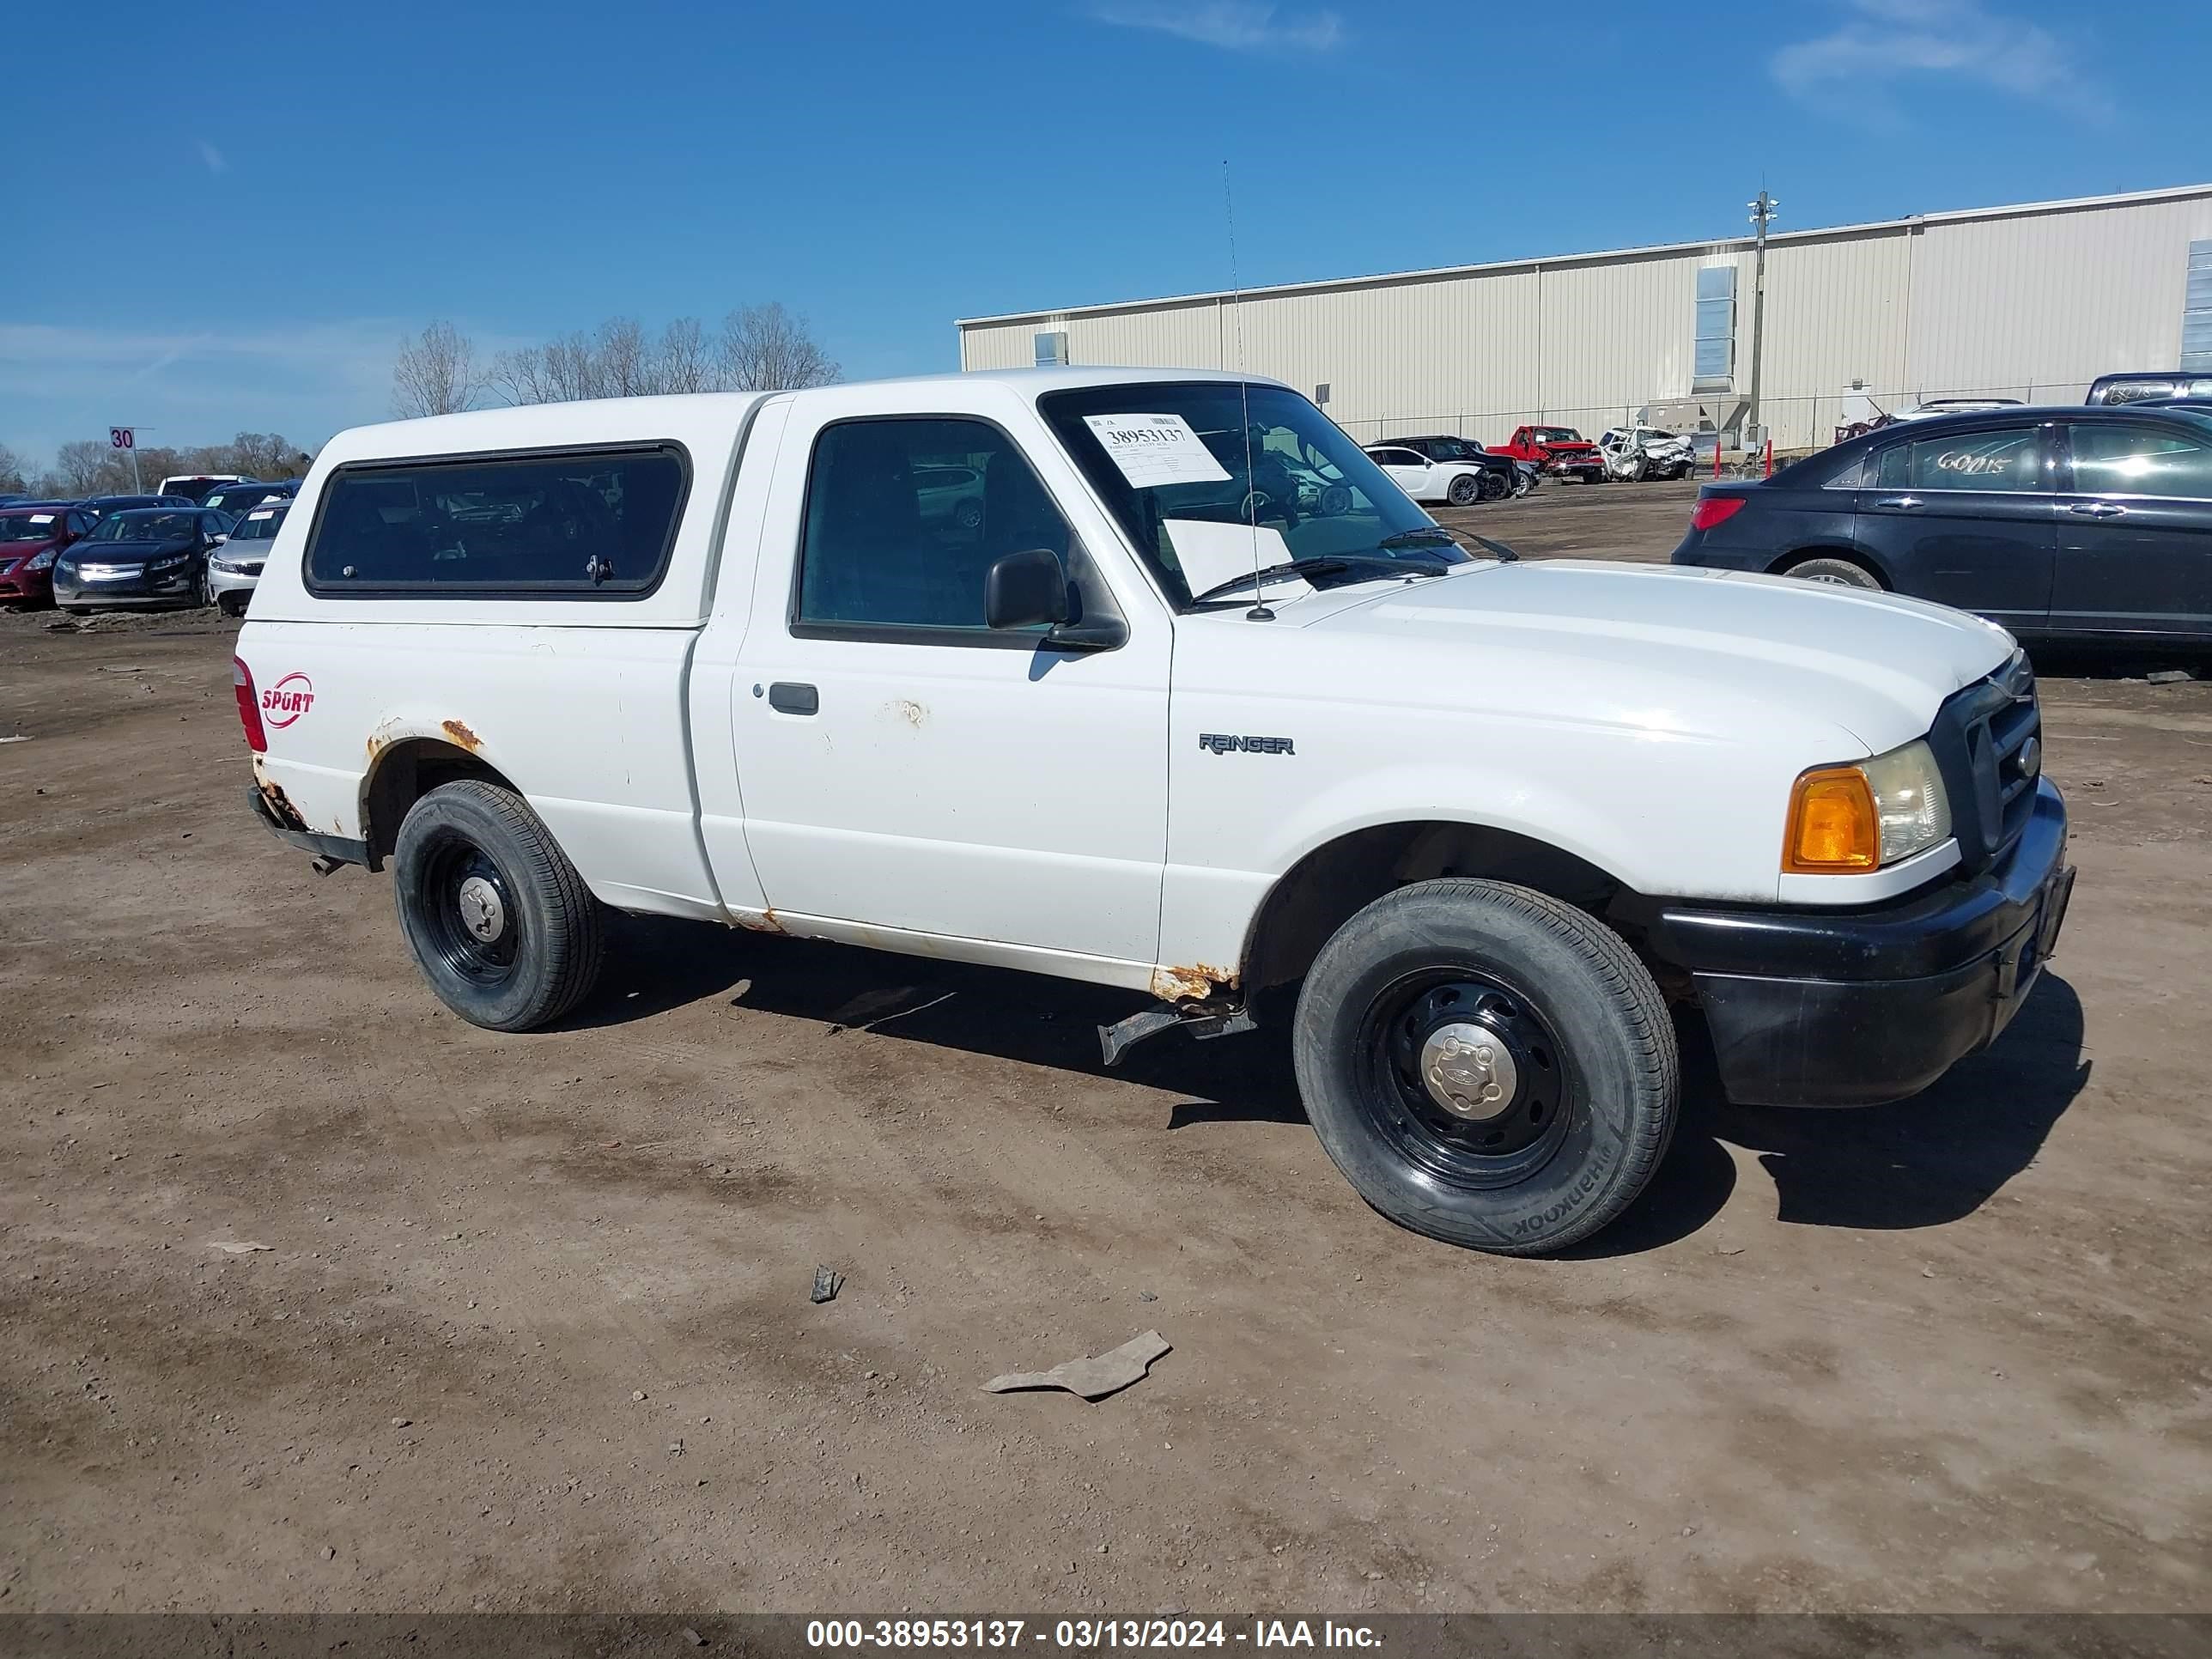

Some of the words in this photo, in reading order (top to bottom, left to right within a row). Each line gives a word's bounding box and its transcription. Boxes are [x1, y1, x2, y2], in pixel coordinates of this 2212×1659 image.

[112, 429, 133, 448] 30
[1106, 428, 1187, 445] 38953137
[262, 690, 314, 713] SPORT
[1199, 732, 1296, 756] RANGER
